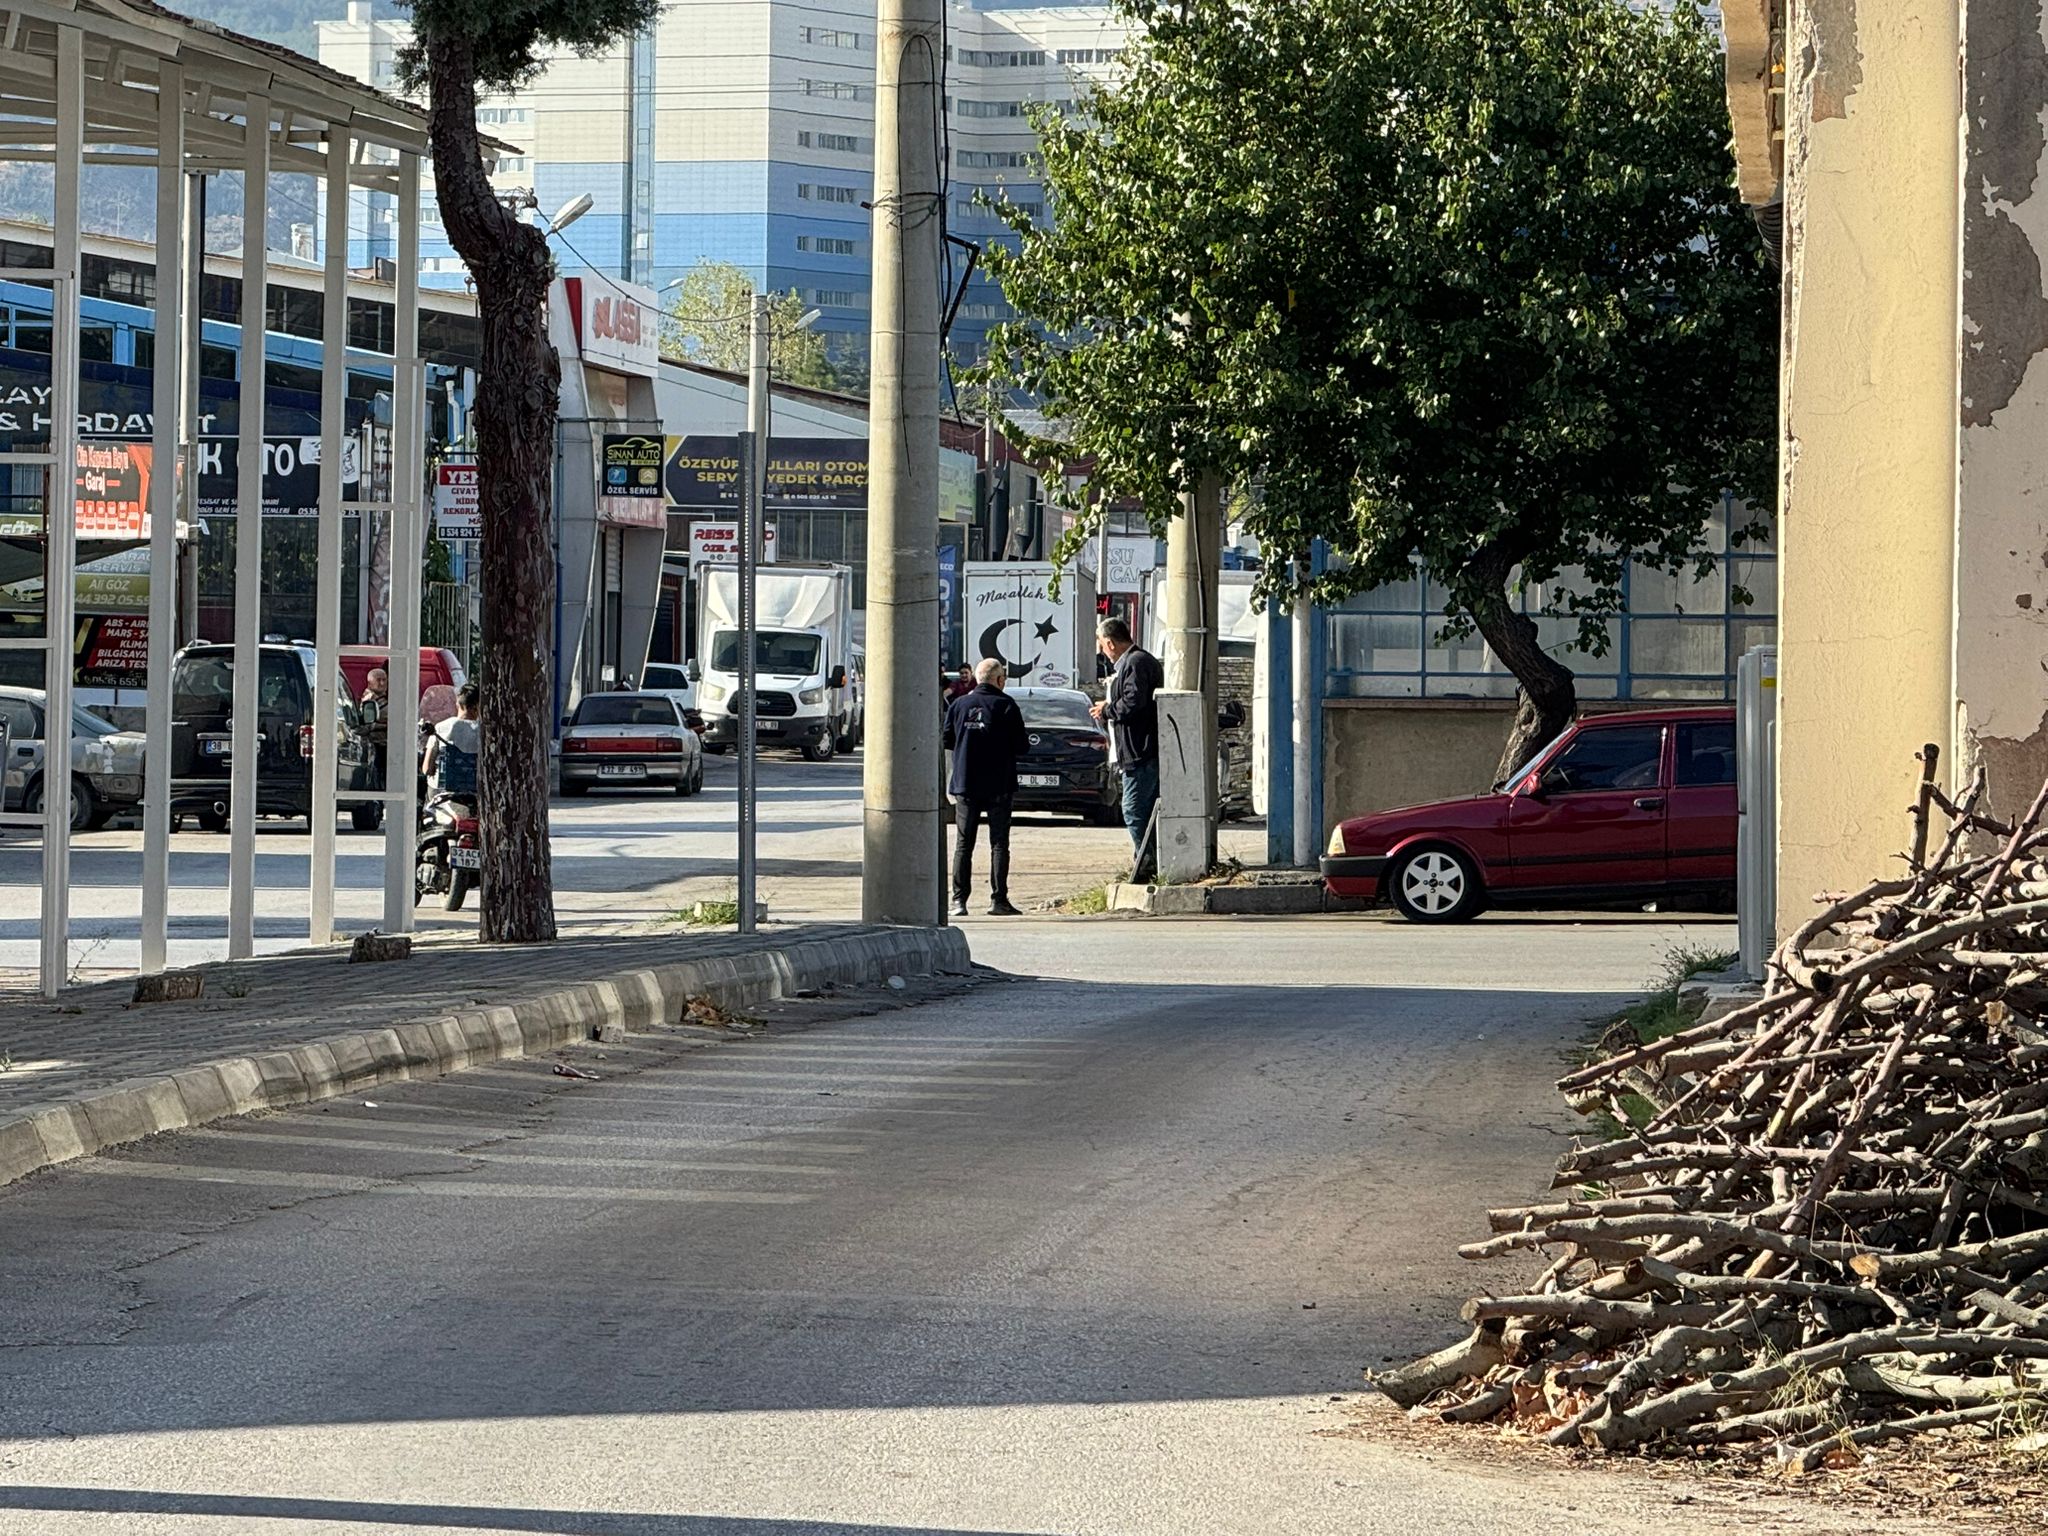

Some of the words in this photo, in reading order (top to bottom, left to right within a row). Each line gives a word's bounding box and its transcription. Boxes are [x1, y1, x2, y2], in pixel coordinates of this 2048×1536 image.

[0, 386, 52, 405] AY
[33, 411, 216, 433] HRDAT
[237, 443, 295, 477] TO
[637, 449, 660, 460] AUTO
[85, 470, 106, 496] Garaj
[696, 472, 739, 483] SERV
[607, 485, 628, 494] ÖZEL
[443, 507, 478, 515] REKORL
[104, 618, 123, 627] ABS
